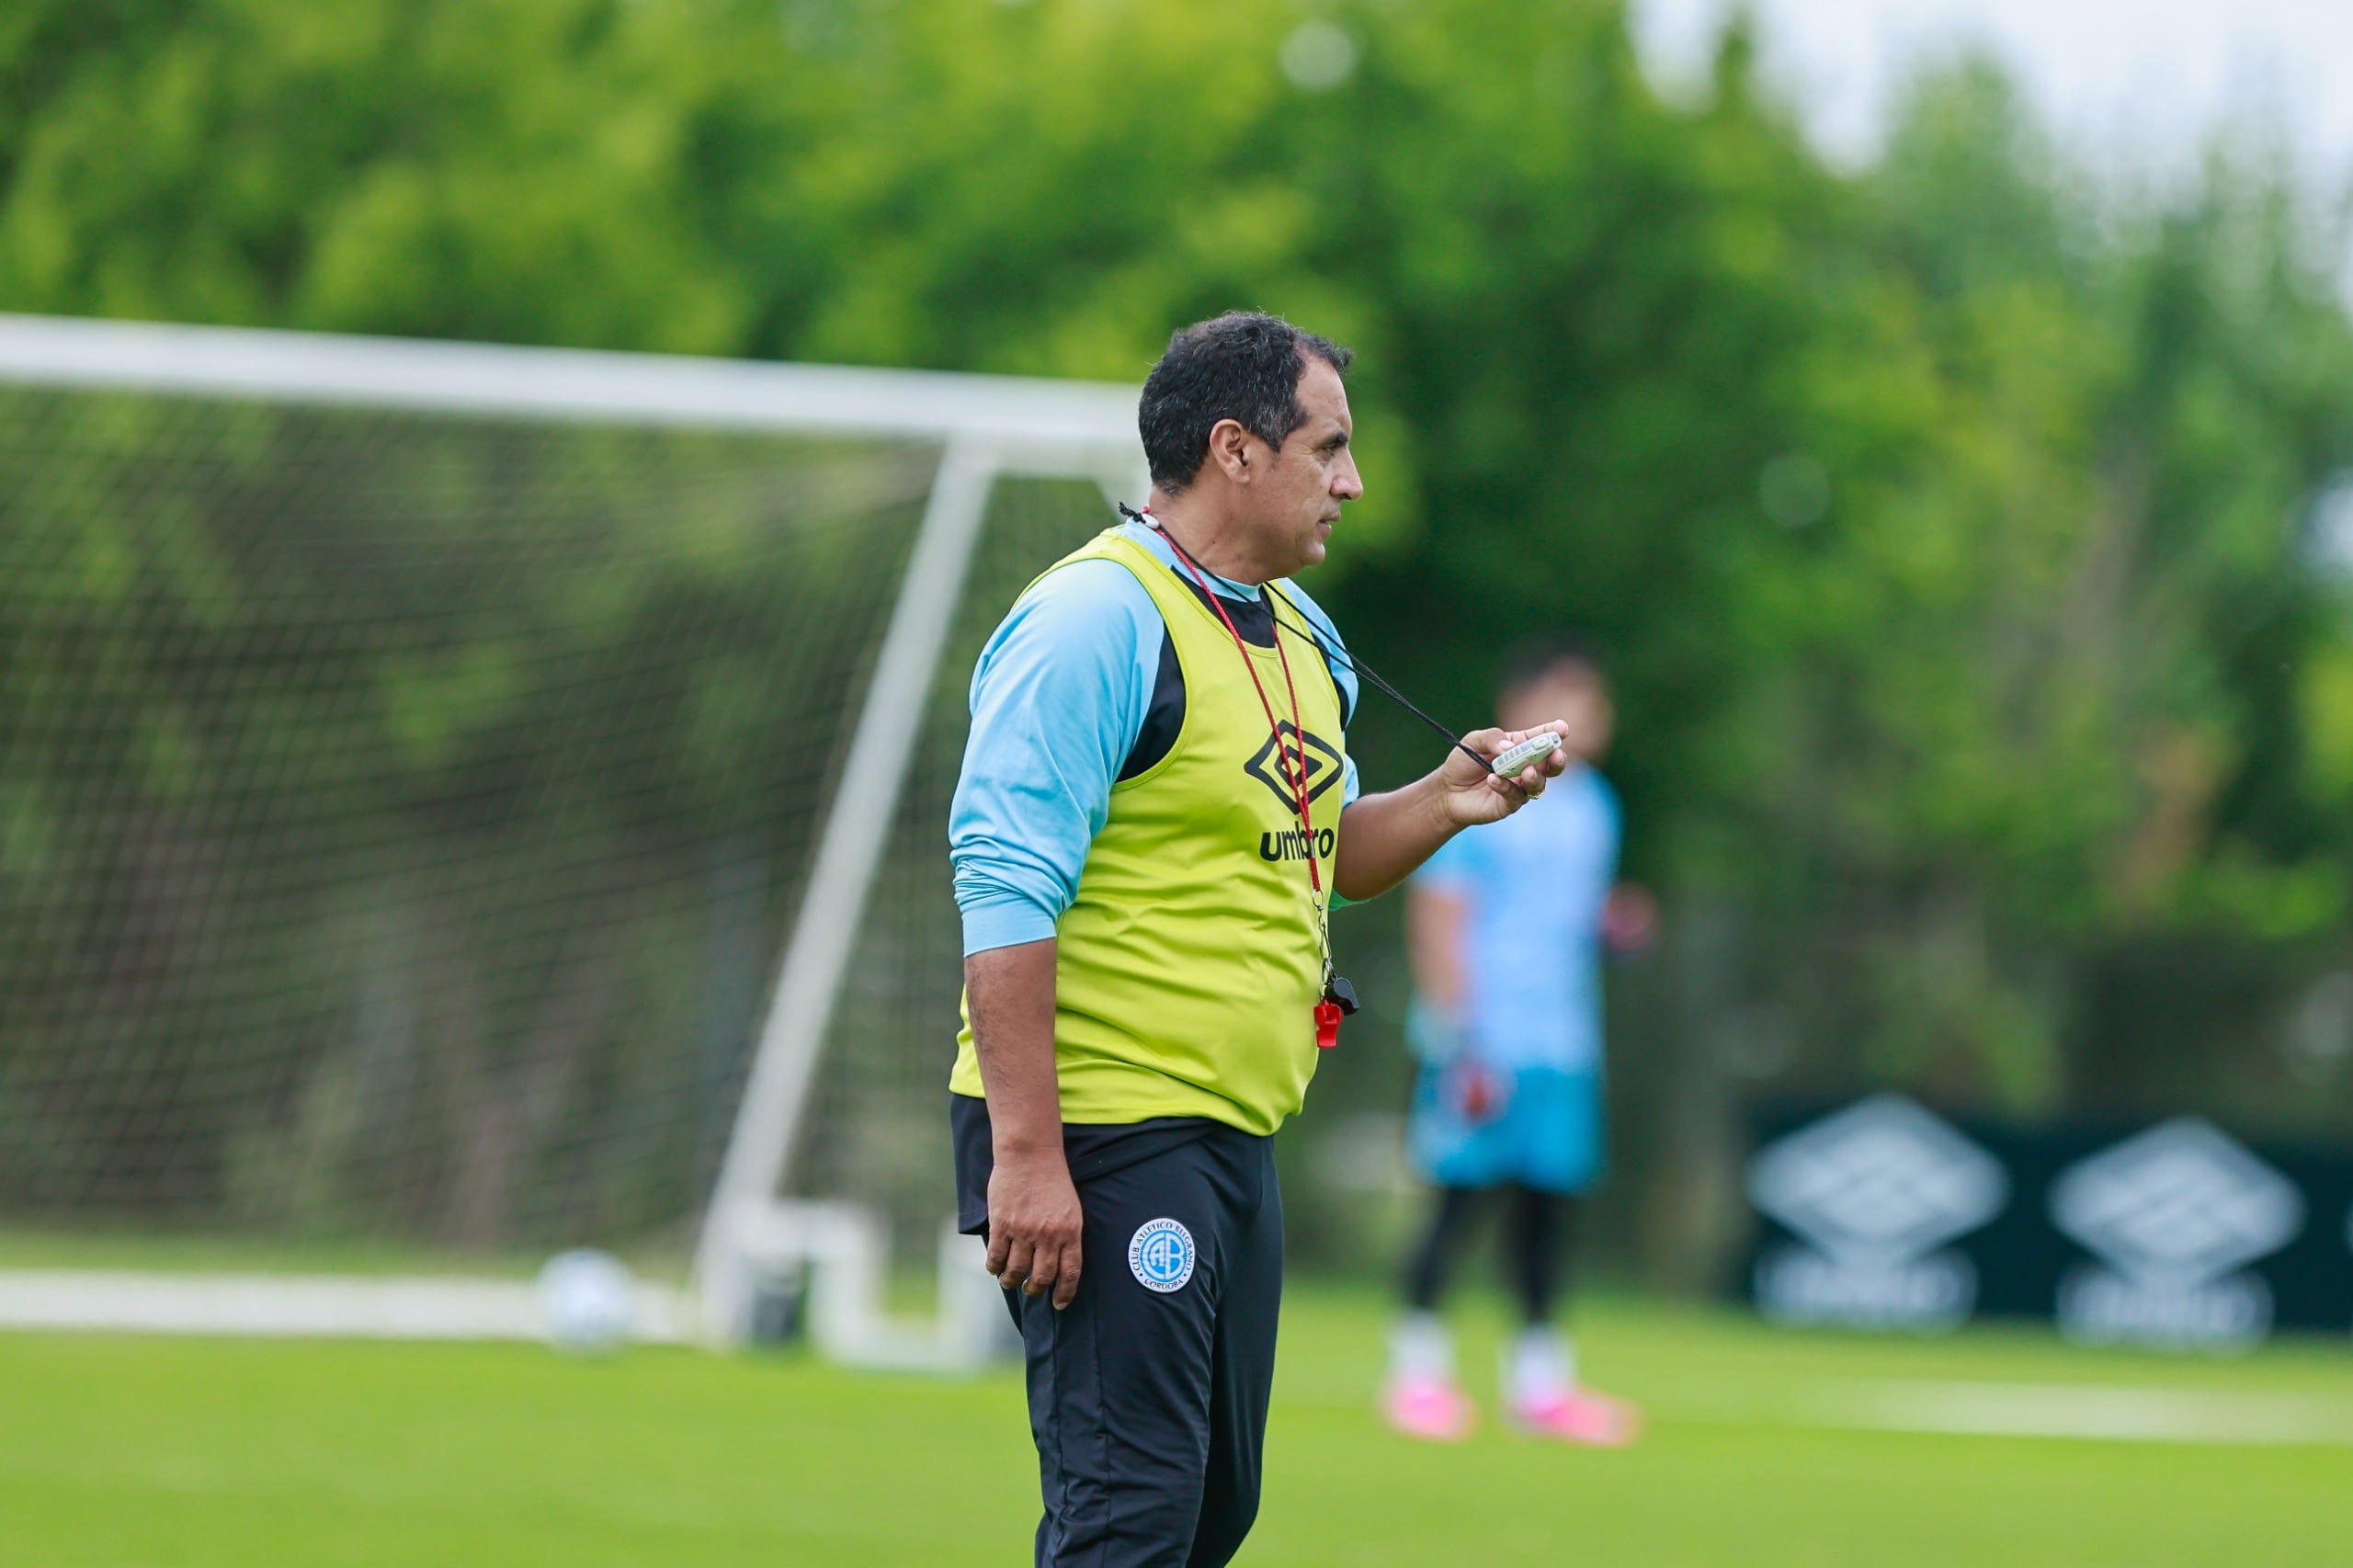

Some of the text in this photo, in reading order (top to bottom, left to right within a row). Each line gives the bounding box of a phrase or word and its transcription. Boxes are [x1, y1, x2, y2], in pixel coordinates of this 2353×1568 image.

[1259, 821, 1335, 861] umbro
[1131, 1221, 1193, 1271] CLUB ATLETICO BELGRANO
[1144, 1278, 1183, 1290] CORDOBA
